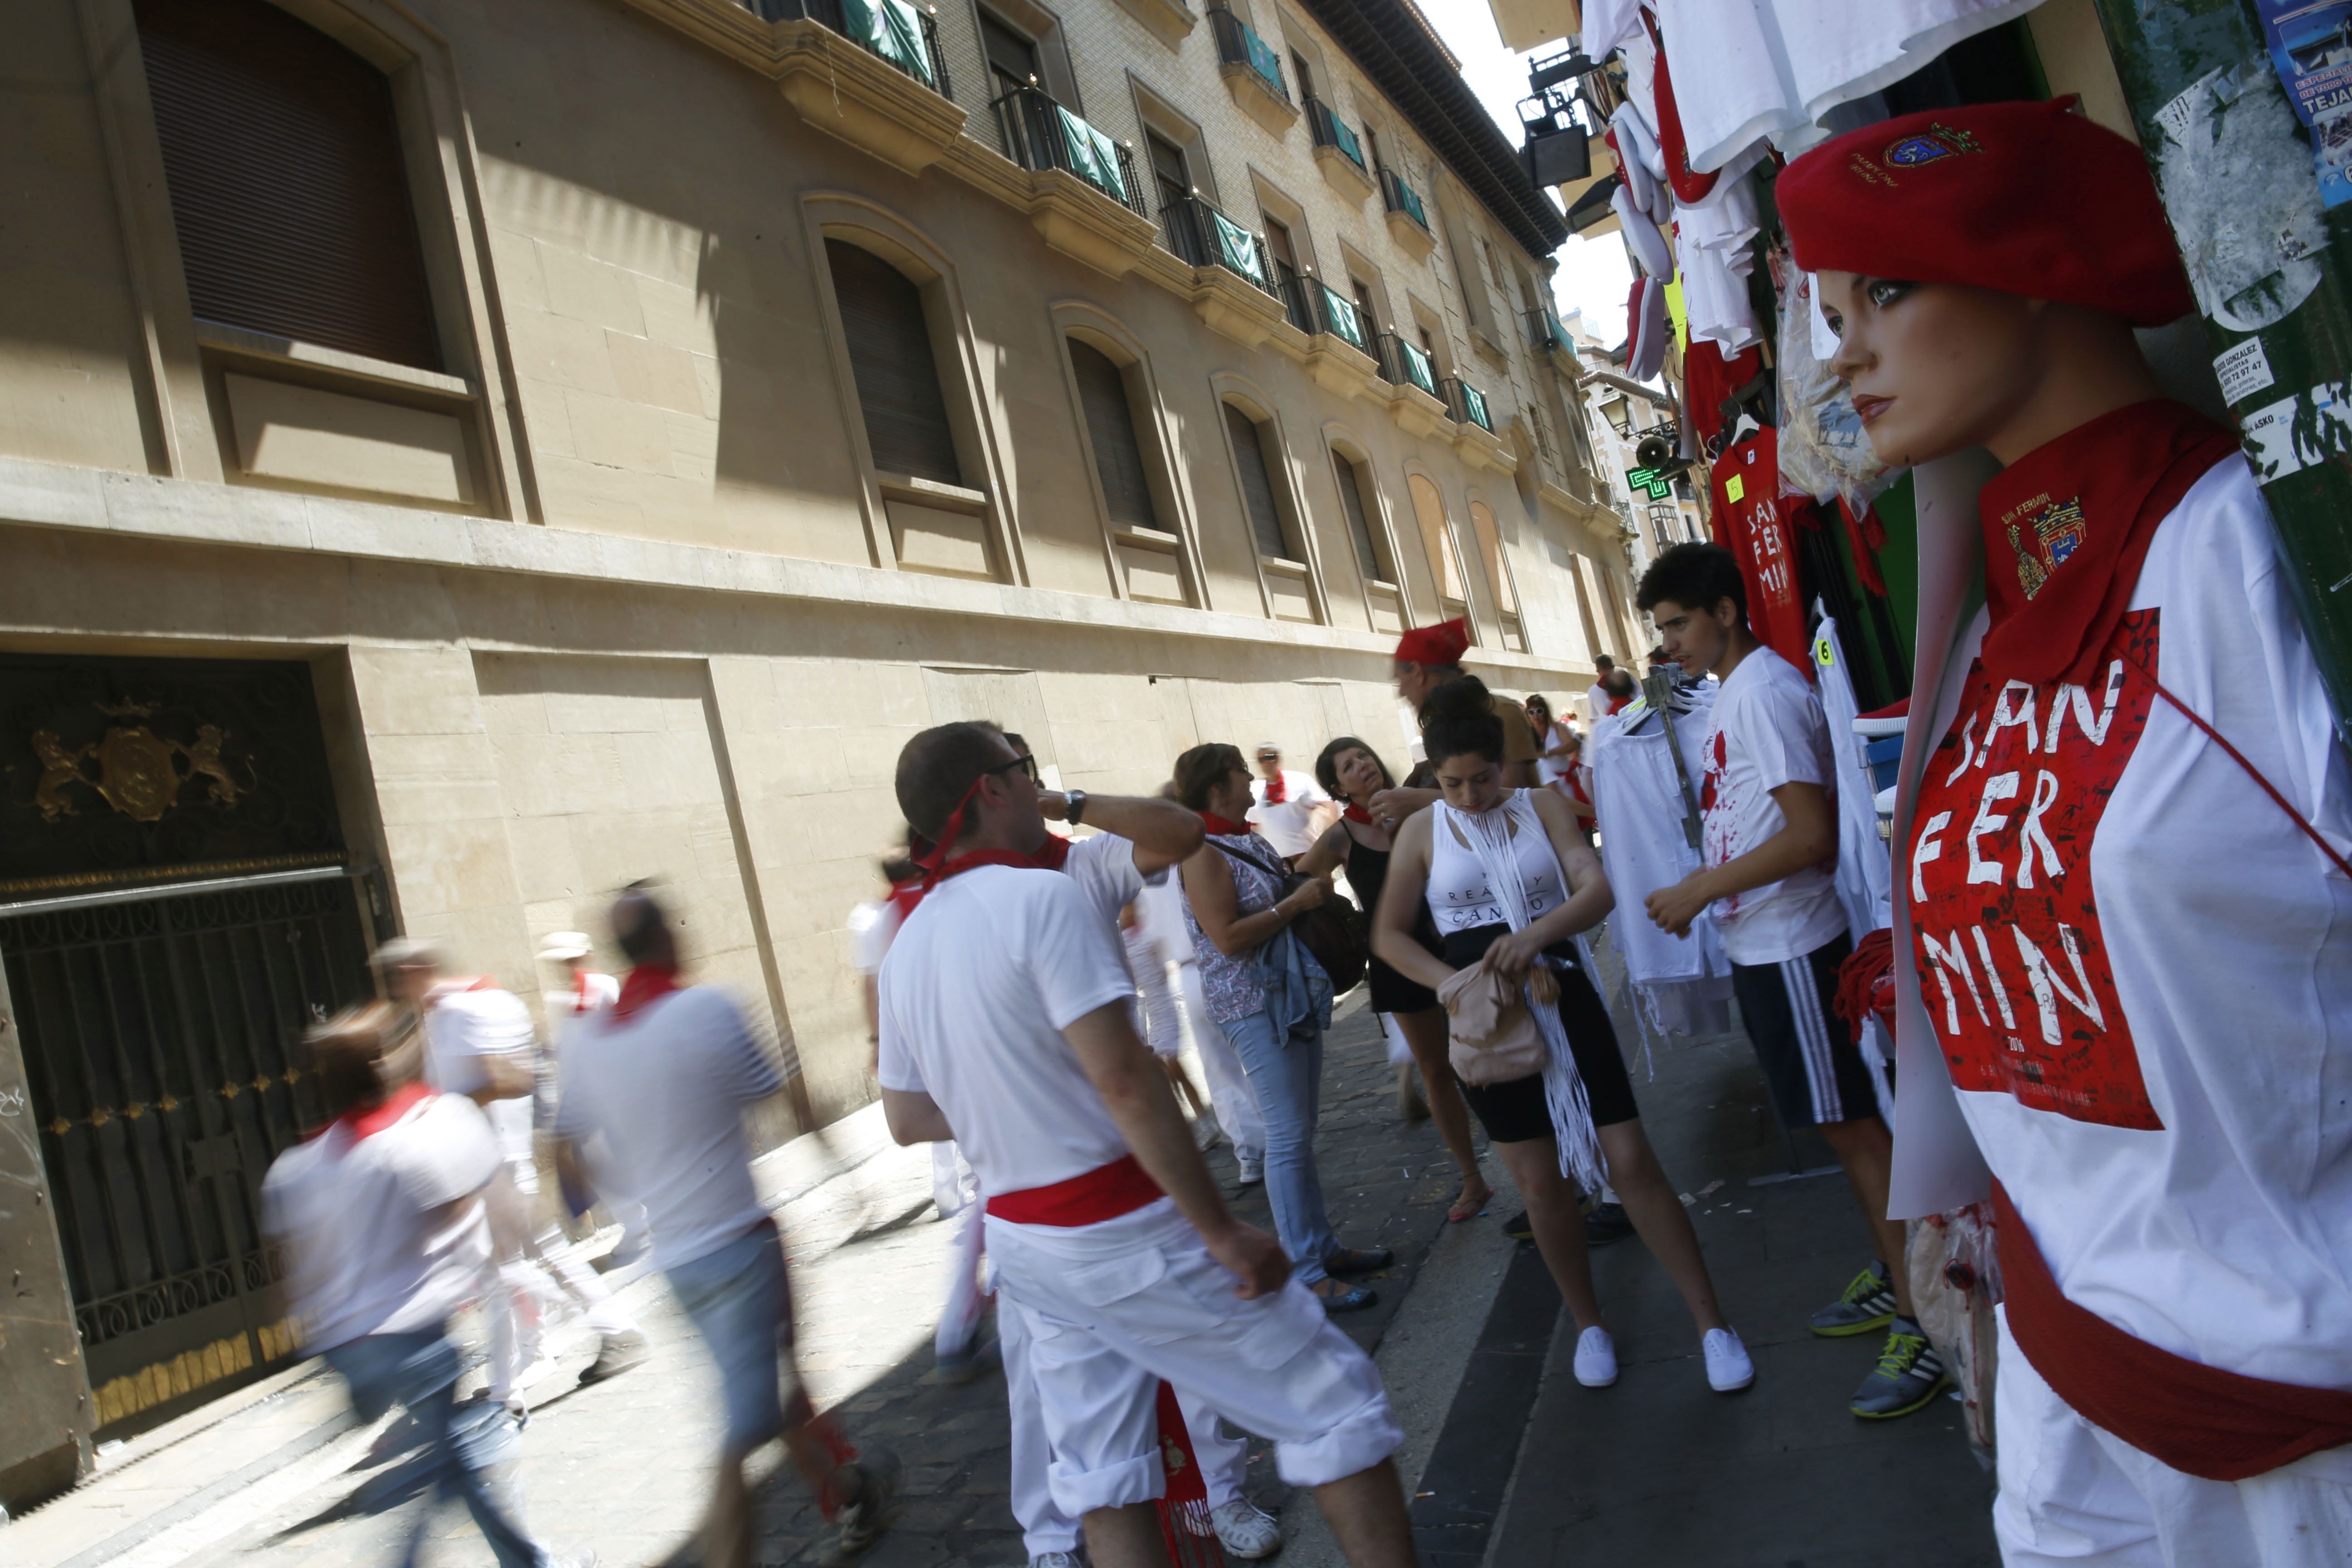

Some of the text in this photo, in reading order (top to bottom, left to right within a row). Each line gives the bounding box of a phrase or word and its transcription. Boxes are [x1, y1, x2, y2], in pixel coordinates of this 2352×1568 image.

[2299, 88, 2315, 99] DE
[2314, 79, 2342, 93] TODO
[2225, 344, 2257, 366] GONZALEZ
[2219, 359, 2249, 379] ESPECIALISTAS
[2231, 372, 2240, 382] 72
[2240, 366, 2249, 377] 97
[2252, 360, 2262, 371] 47
[1730, 481, 1739, 499] 5
[1747, 497, 1777, 535] SAN
[2001, 491, 2051, 524] SAN FERMIN
[1753, 524, 1782, 565] FER
[1759, 558, 1788, 599] MIN
[1820, 641, 1828, 660] 6
[1945, 658, 2123, 788] SAN
[1912, 769, 2065, 903] FER
[1448, 876, 1543, 901] REAY
[1453, 906, 1501, 923] CAN
[1921, 922, 2107, 1046] MIN
